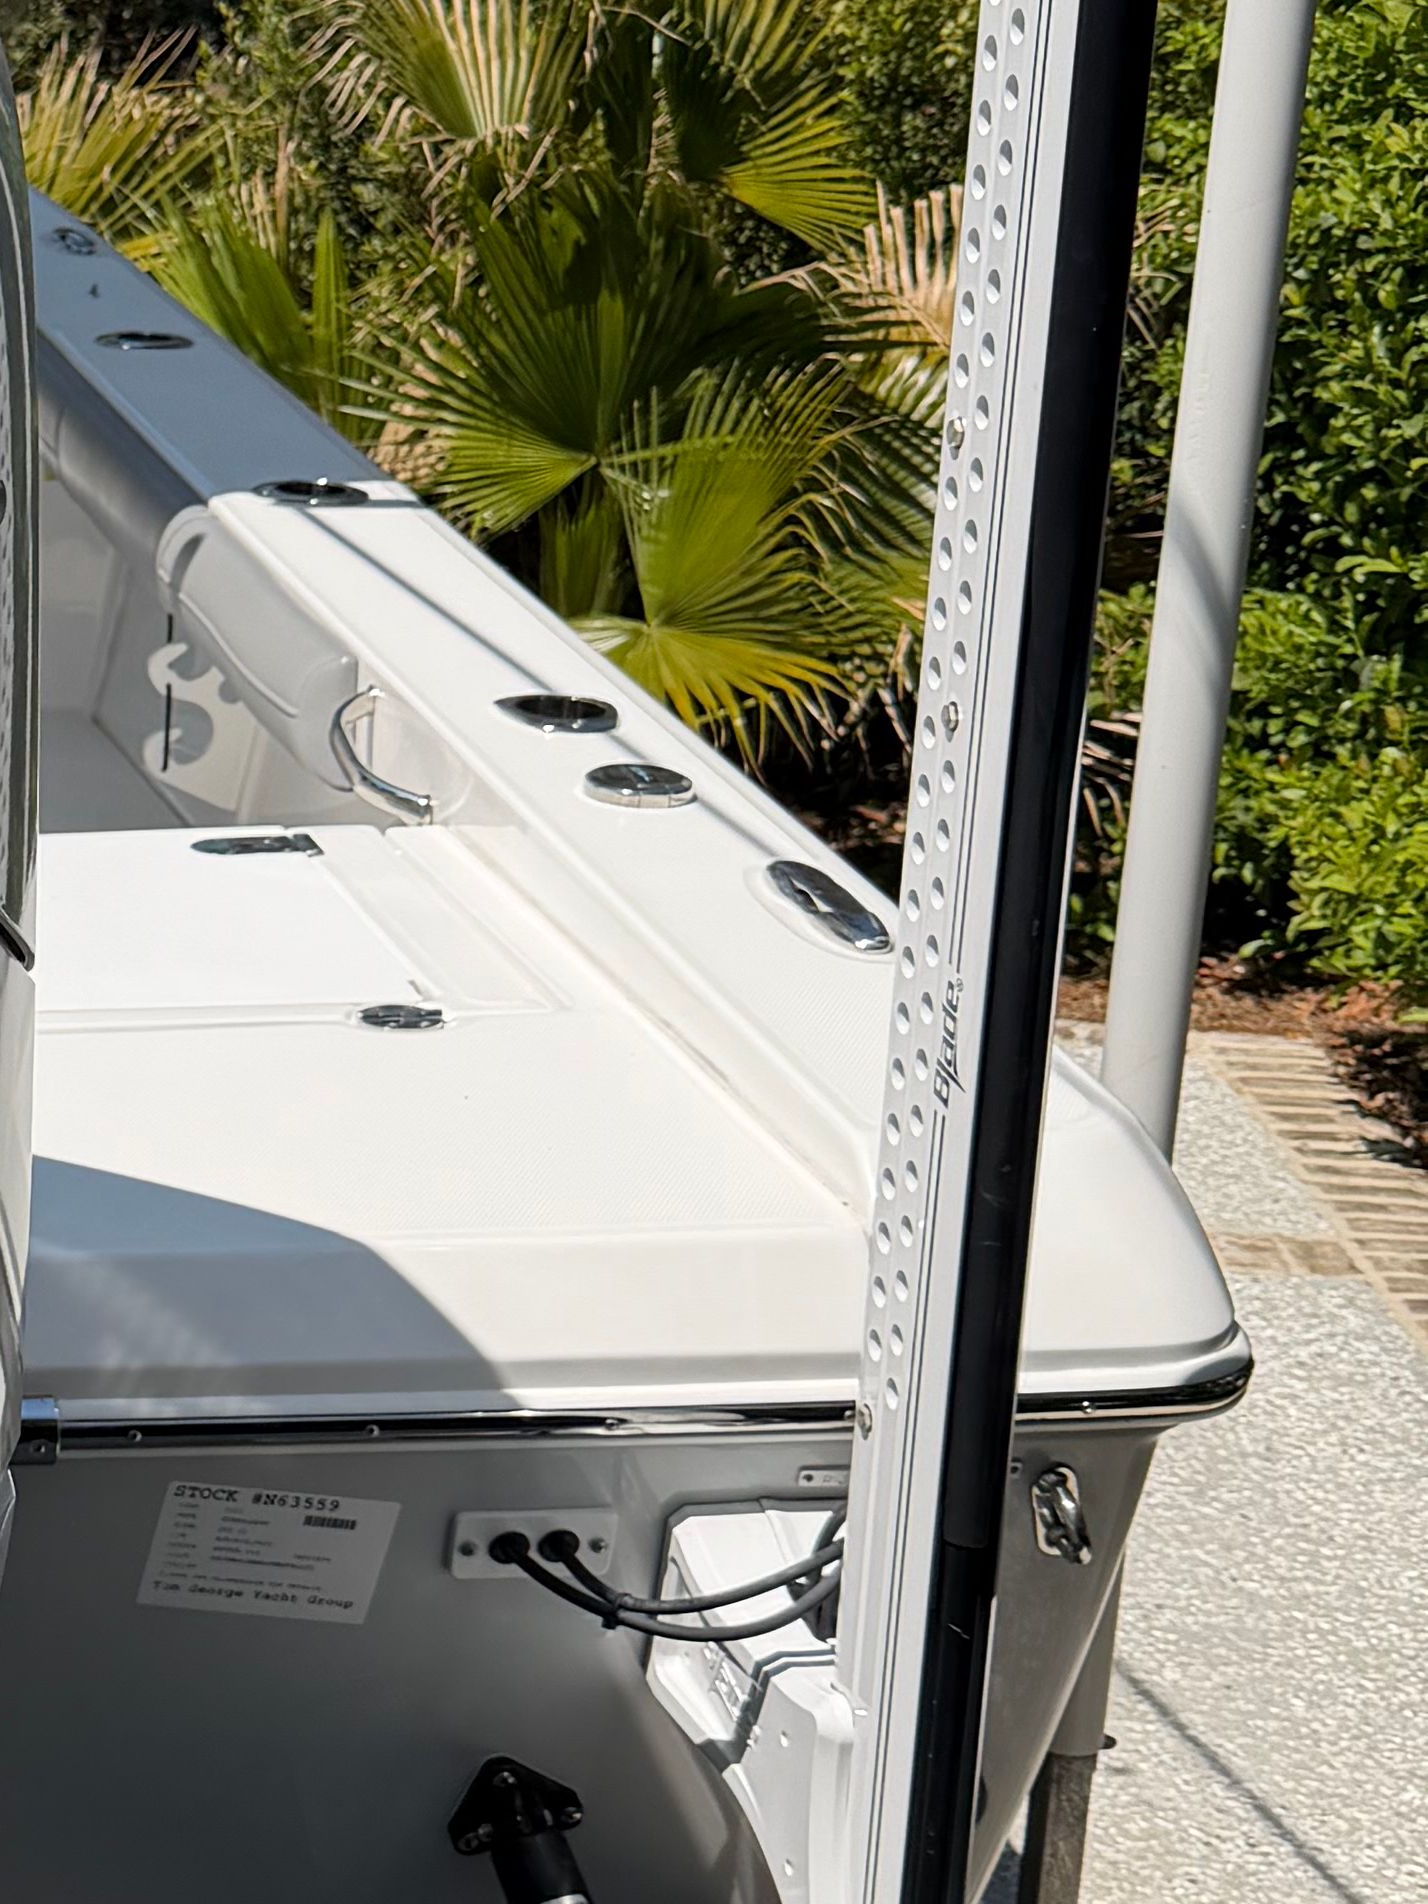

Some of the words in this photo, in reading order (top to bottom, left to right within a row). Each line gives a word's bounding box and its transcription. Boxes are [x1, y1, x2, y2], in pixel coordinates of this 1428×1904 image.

[173, 1484, 239, 1503] STOCK
[251, 1492, 341, 1512] #N63559
[190, 1582, 244, 1599] George
[252, 1589, 299, 1605] Yacht
[307, 1594, 354, 1610] Group
